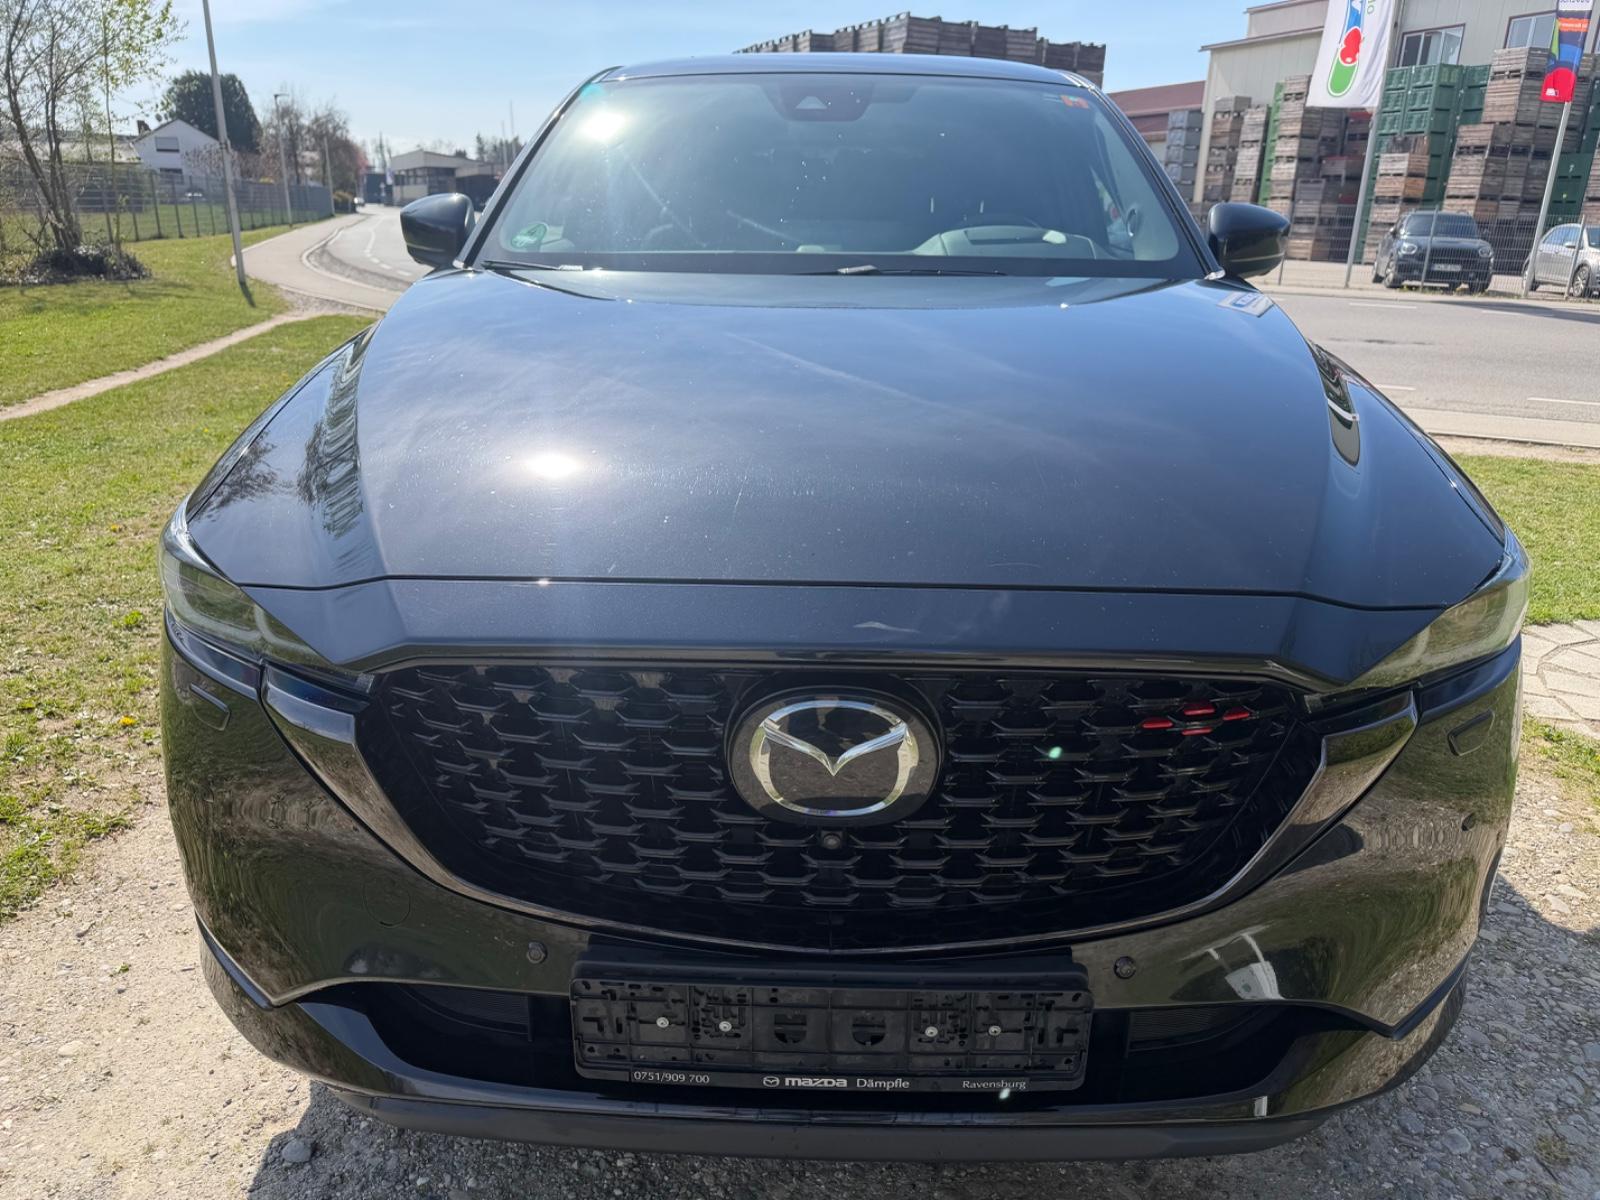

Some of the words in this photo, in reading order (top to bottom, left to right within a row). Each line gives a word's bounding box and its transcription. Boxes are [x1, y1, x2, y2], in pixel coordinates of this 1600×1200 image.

[633, 1071, 686, 1083] 0751/909
[689, 1074, 710, 1084] 700
[784, 1077, 848, 1088] mazda
[856, 1078, 910, 1091] Dämpfle
[962, 1080, 1027, 1090] Ravensburg
